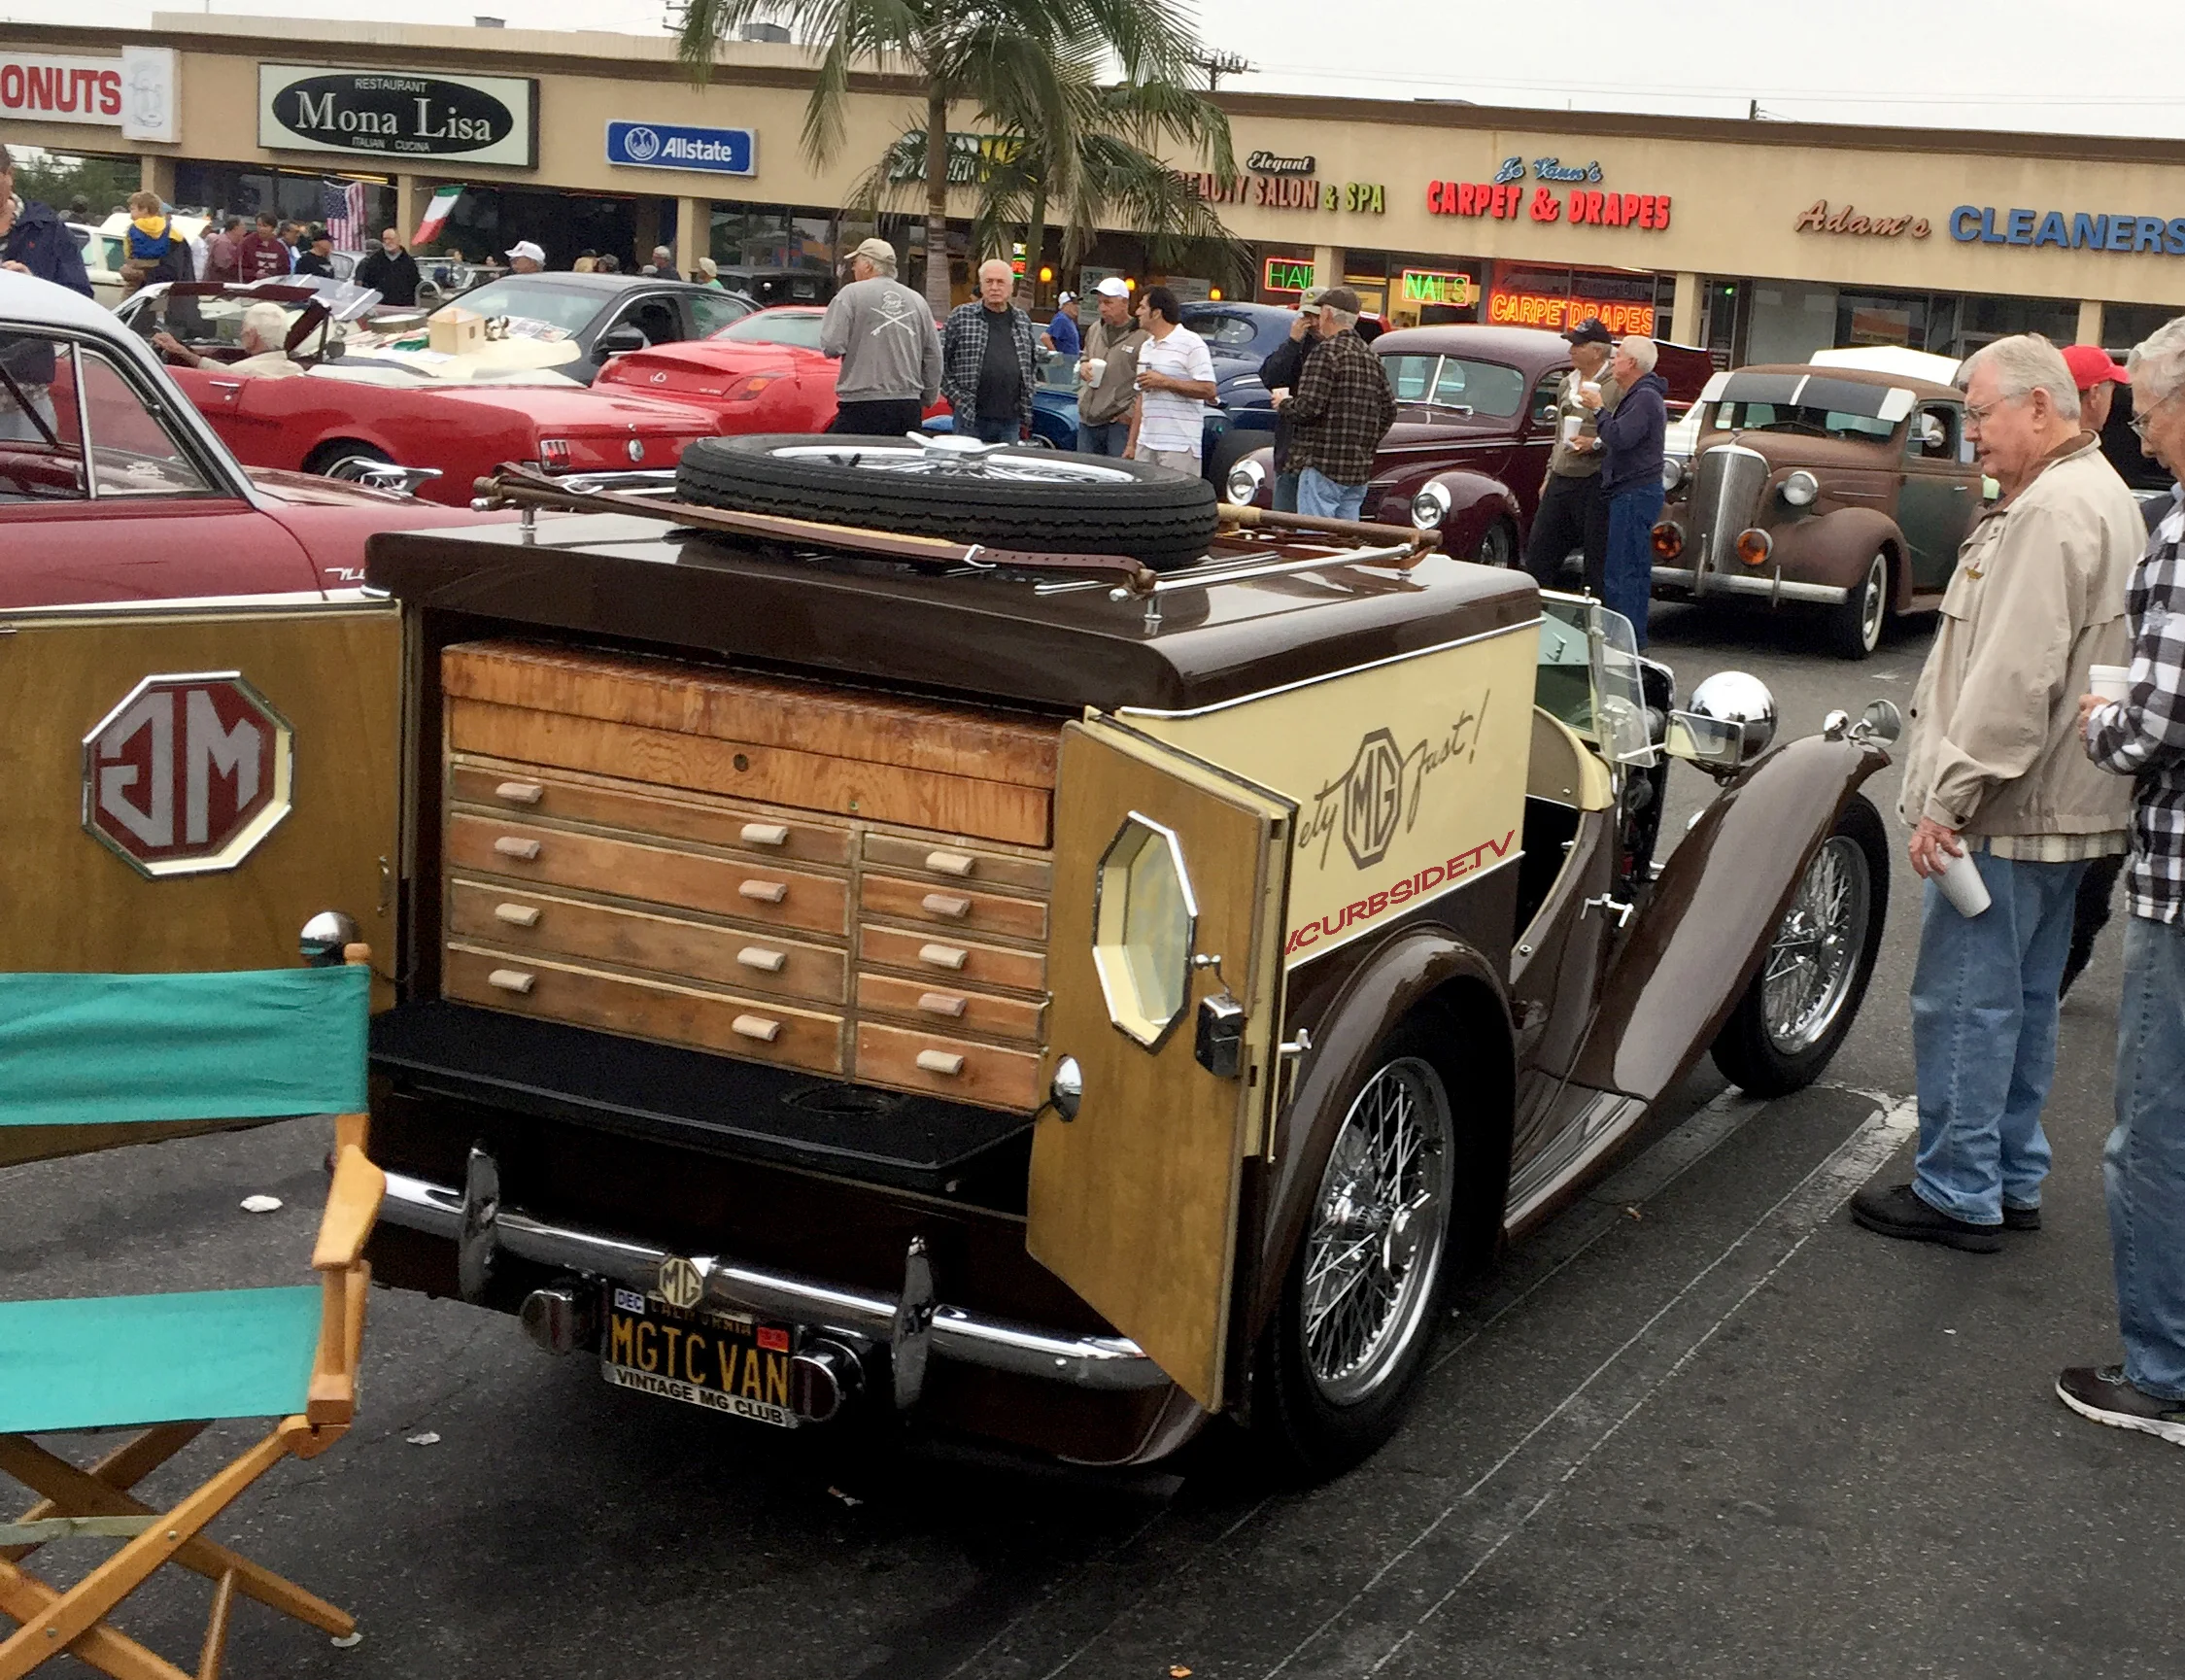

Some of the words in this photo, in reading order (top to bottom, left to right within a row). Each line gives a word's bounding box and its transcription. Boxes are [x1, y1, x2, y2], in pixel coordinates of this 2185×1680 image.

[0, 64, 121, 115] ONUTS
[354, 78, 428, 93] RESTAURANT
[294, 90, 398, 135] Mona
[413, 97, 492, 141] Lisa
[352, 136, 386, 149] ITALIAN
[394, 140, 430, 153] CUCINA
[661, 137, 733, 162] Allstate
[1247, 151, 1311, 173] Elegant
[1254, 175, 1319, 210] SALON
[1324, 185, 1338, 211] &
[1345, 182, 1385, 213] SPA
[1427, 180, 1522, 219] CARPET
[1528, 187, 1559, 223] &
[1567, 189, 1670, 229] DRAPES
[1793, 199, 1932, 240] Adam's
[1949, 205, 2185, 255] CLEANERS
[1405, 273, 1466, 303] NAILS
[1490, 294, 1567, 326] CARPE
[1349, 737, 1399, 859] MG
[617, 1291, 643, 1312] DEC
[662, 1259, 701, 1307] MG
[611, 1313, 707, 1385] MGTC
[717, 1339, 789, 1408] VAN
[615, 1368, 695, 1401] VINTAGE
[699, 1390, 729, 1410] MG
[734, 1399, 784, 1424] CLUB
